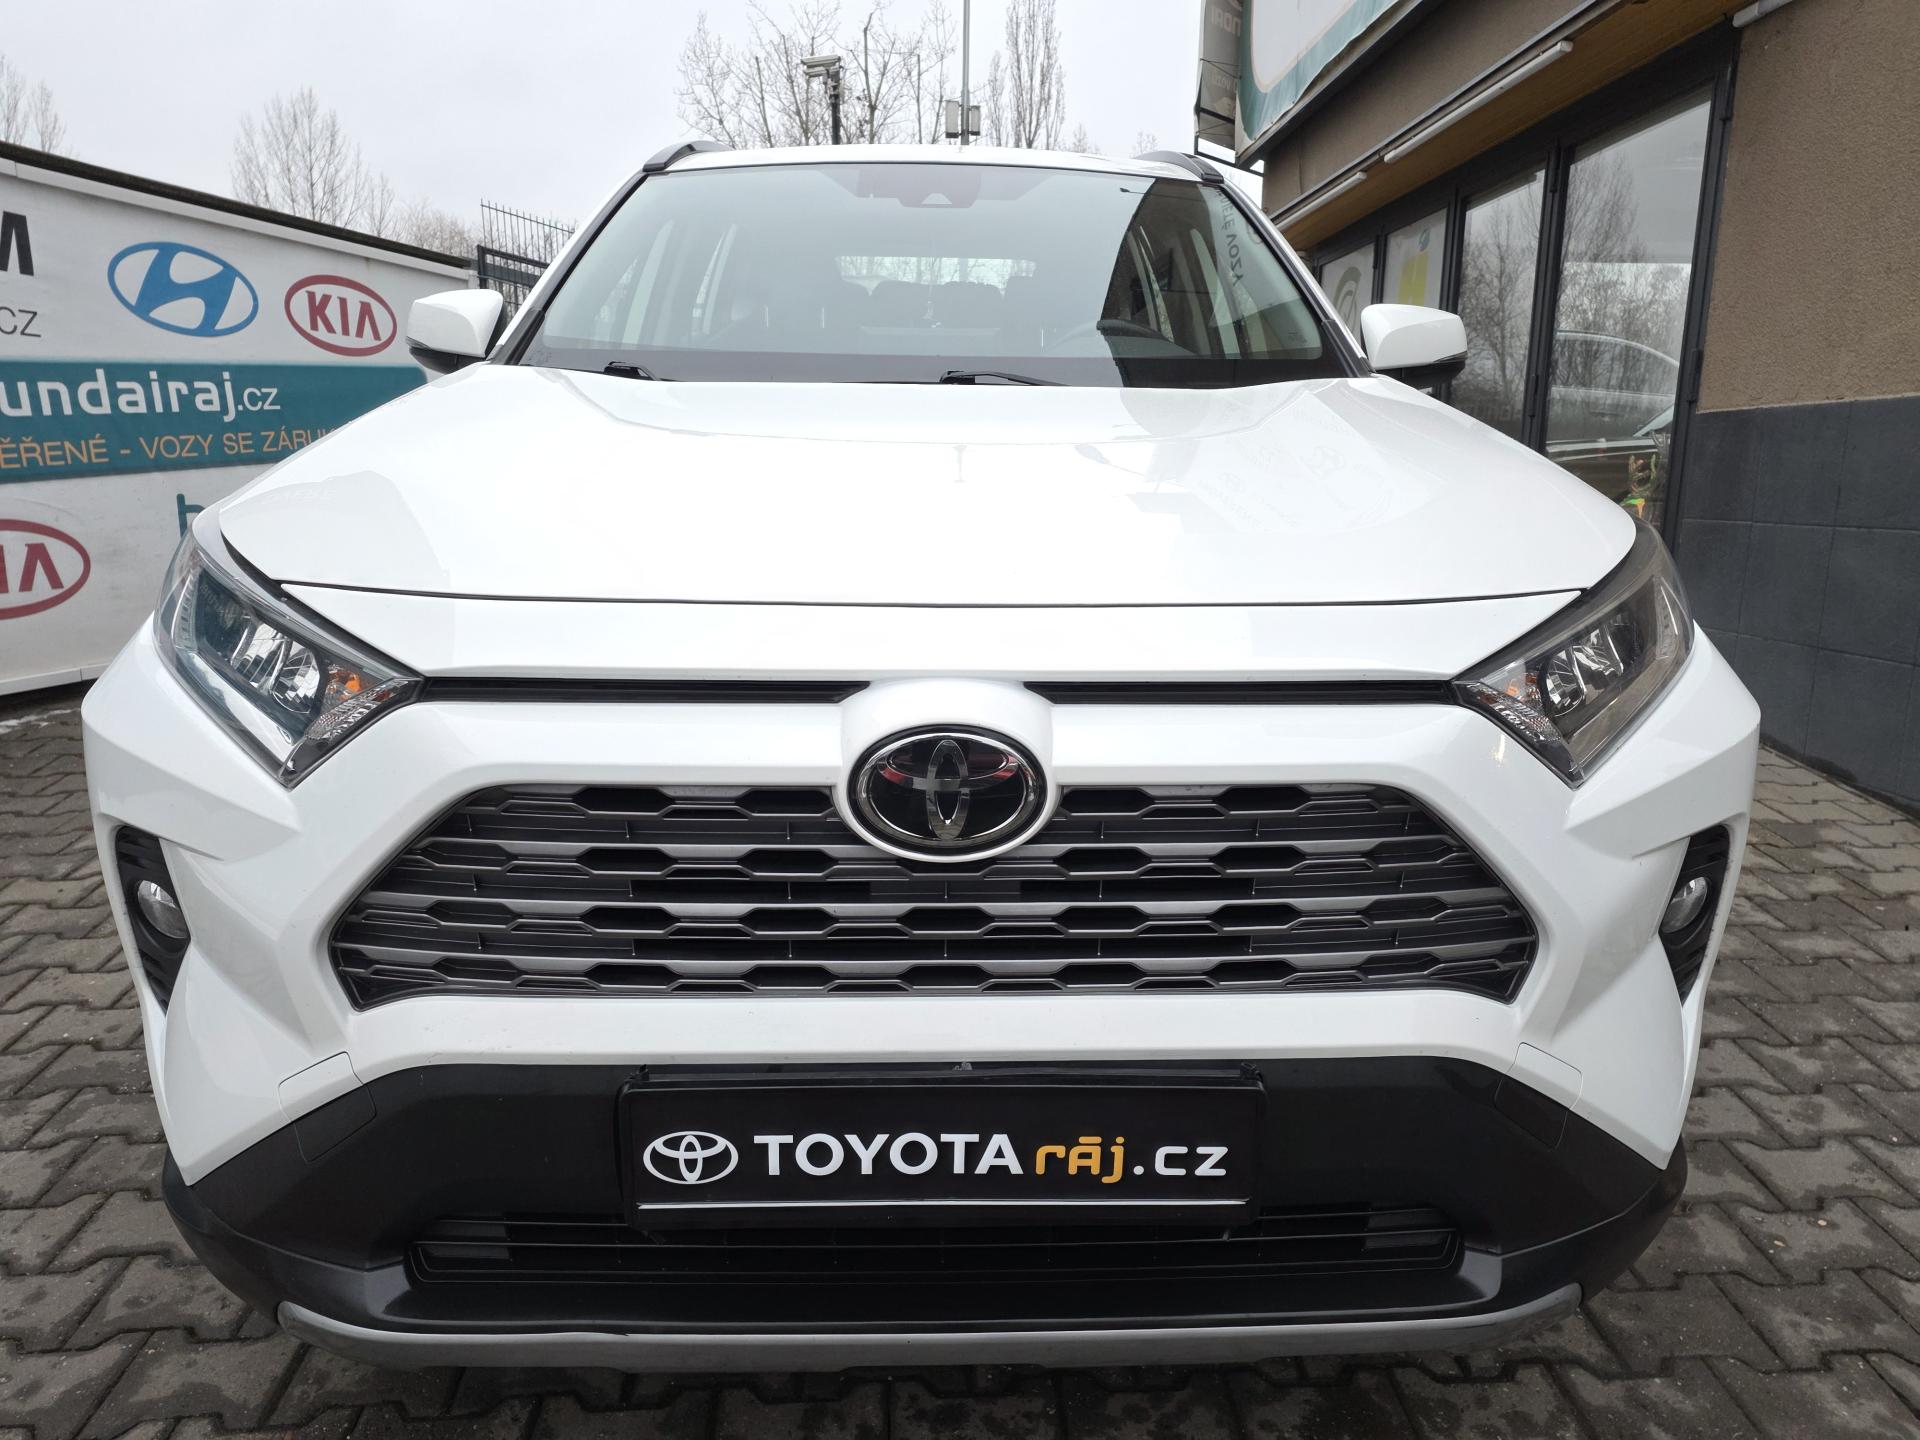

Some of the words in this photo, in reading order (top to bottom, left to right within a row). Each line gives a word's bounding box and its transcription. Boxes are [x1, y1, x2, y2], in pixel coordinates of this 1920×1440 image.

[305, 290, 382, 341] KIA
[139, 433, 213, 460] VOZY
[223, 432, 255, 455] SE
[754, 1132, 1024, 1176] TOYOTA
